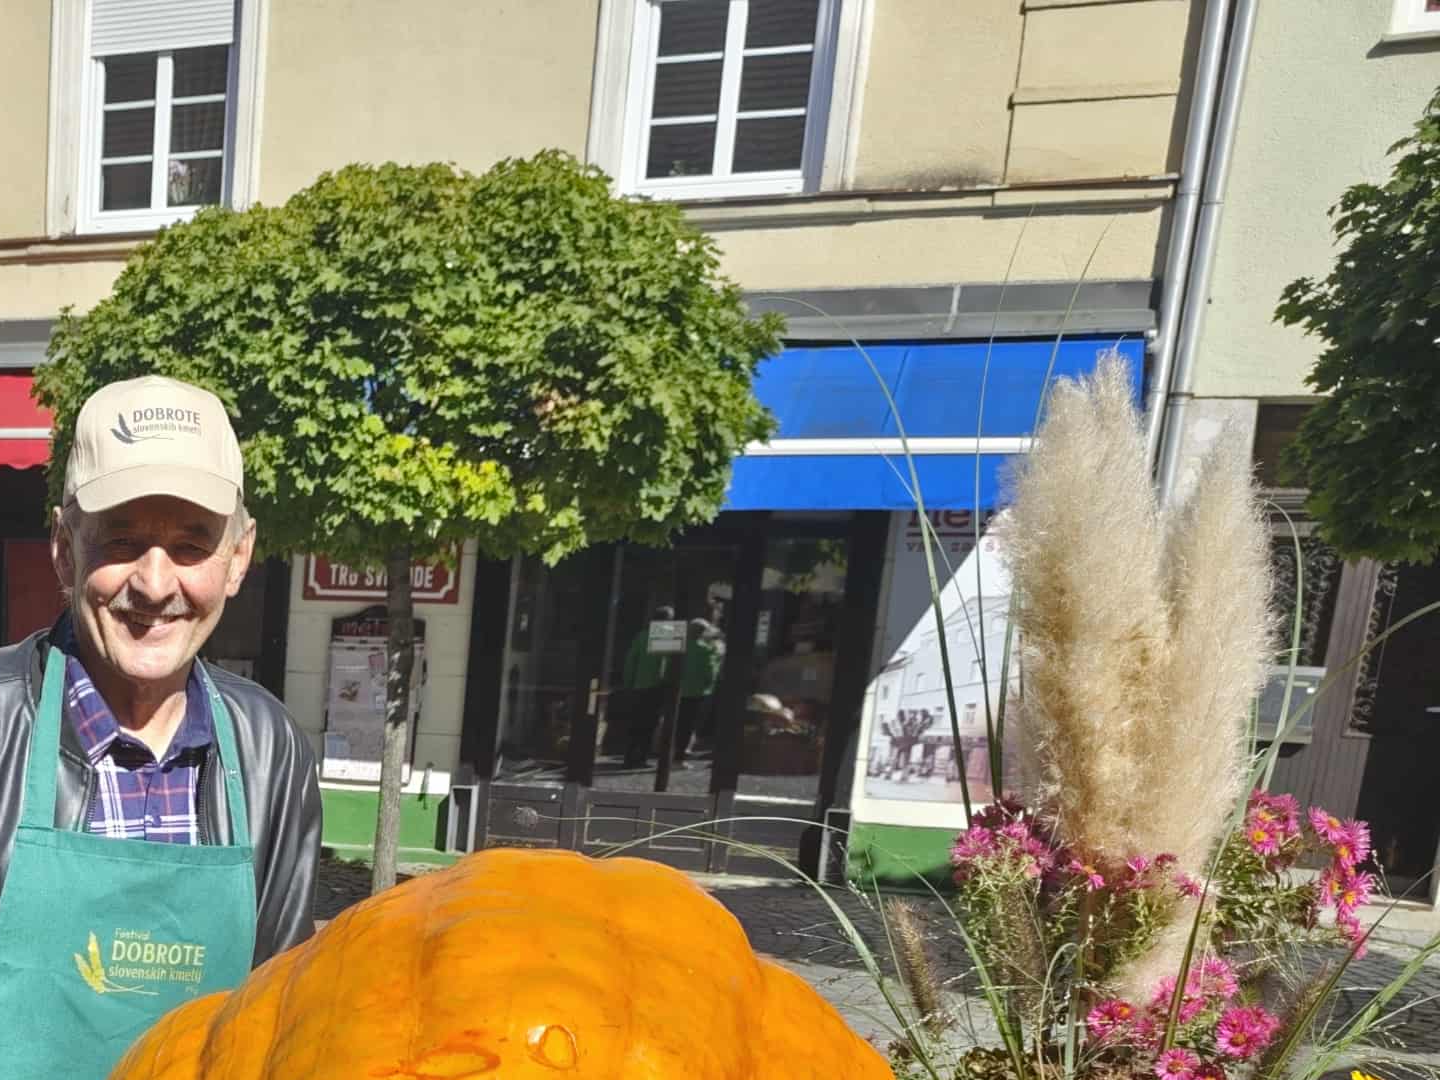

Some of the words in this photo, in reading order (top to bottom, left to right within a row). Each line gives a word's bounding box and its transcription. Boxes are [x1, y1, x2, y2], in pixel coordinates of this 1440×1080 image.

[133, 408, 201, 426] DOBROTE
[330, 564, 359, 587] TRG
[364, 565, 434, 589] SVDE
[112, 940, 206, 966] DOBROTE
